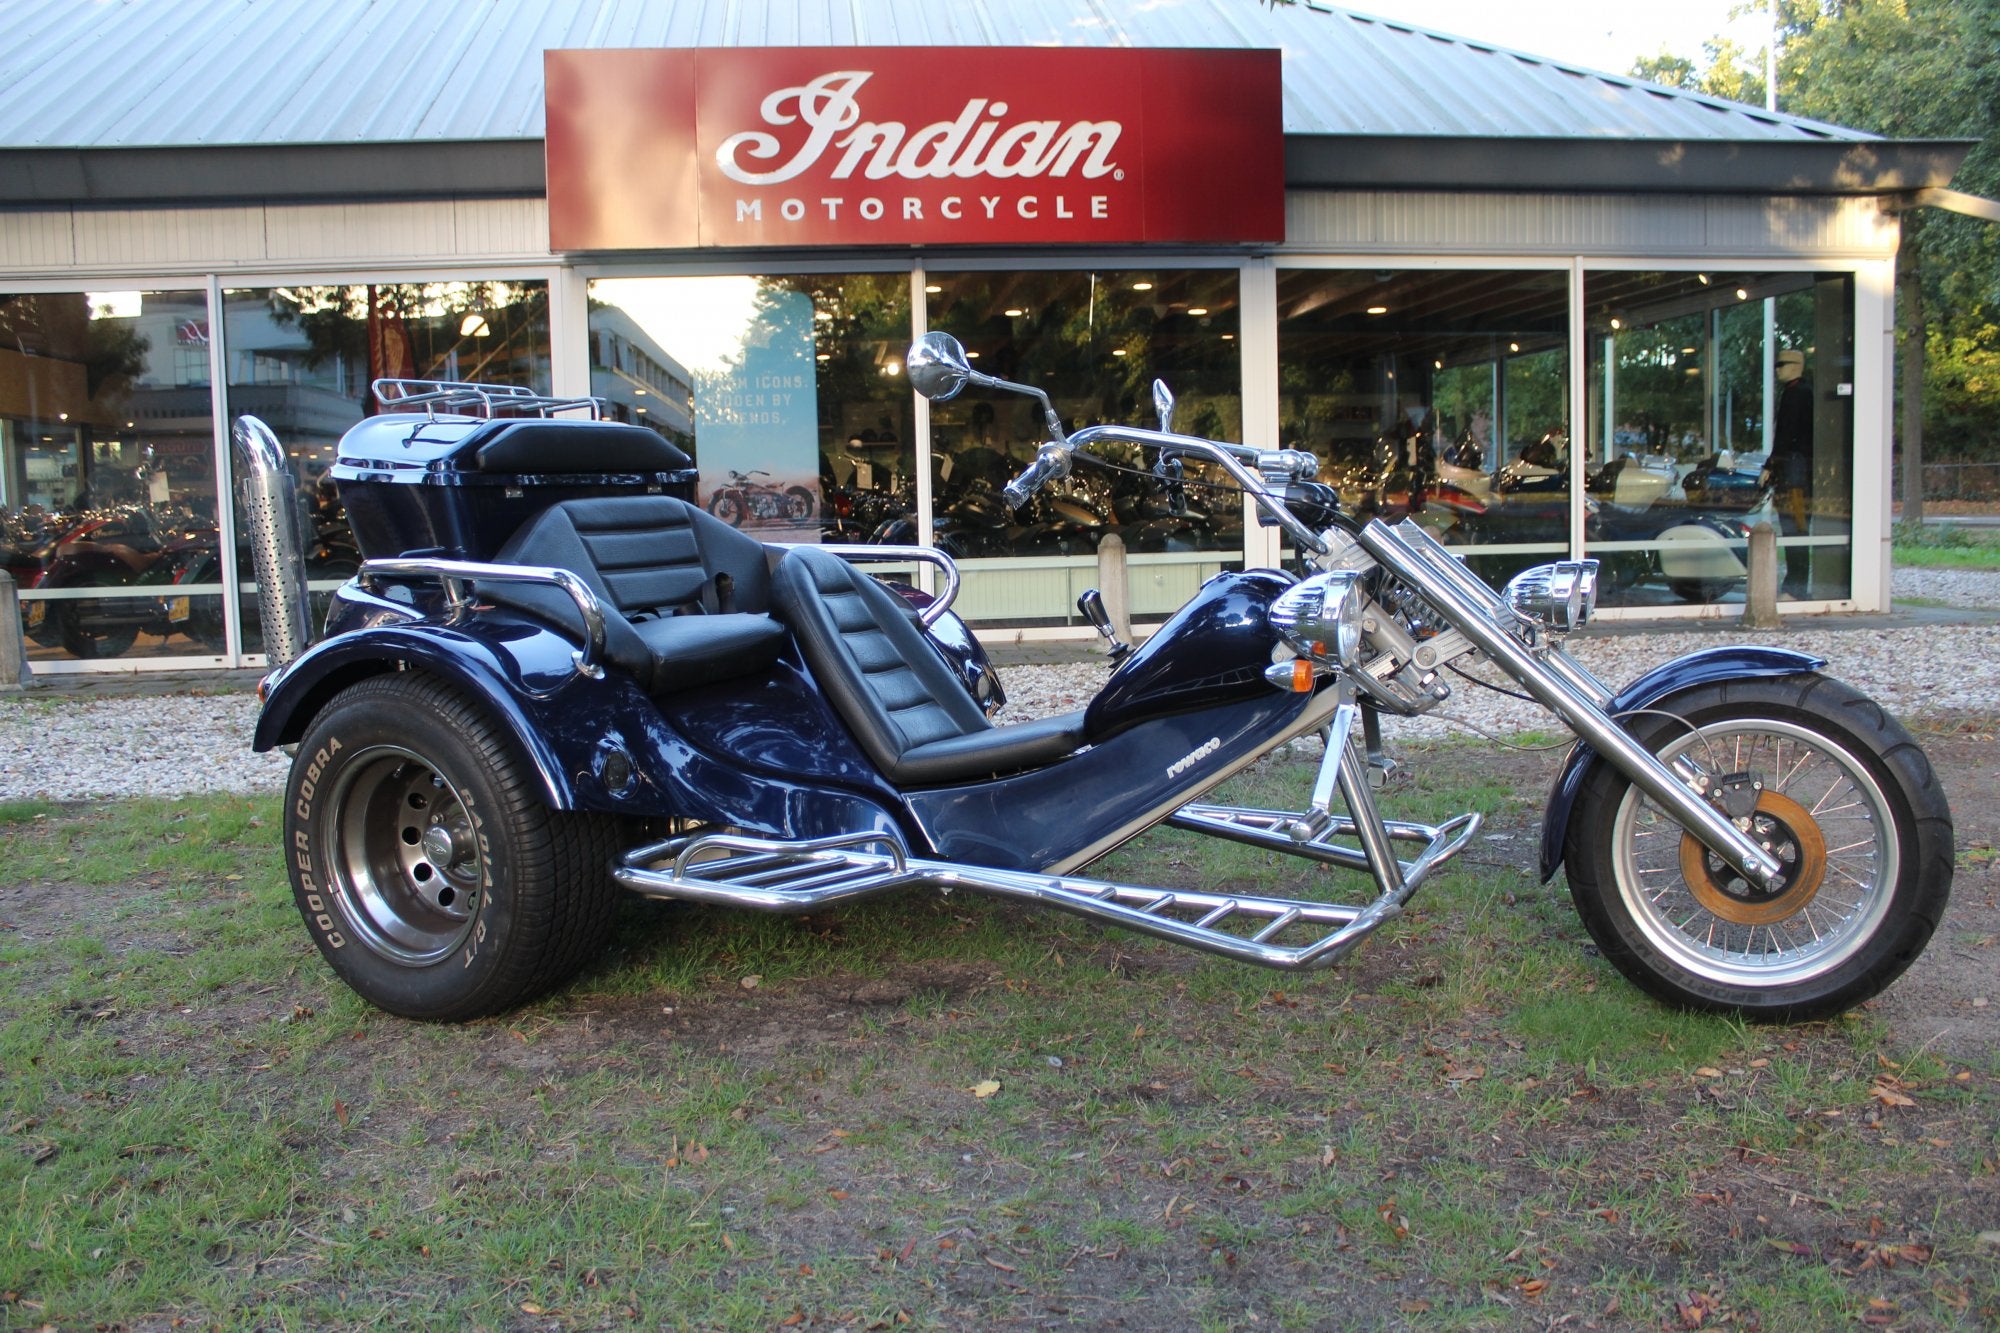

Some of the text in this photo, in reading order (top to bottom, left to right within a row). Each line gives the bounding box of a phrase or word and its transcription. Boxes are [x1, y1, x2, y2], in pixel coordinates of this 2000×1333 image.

[736, 195, 1109, 222] MOTORCYCLE
[755, 375, 808, 389] ICONS.
[772, 393, 792, 407] BY
[296, 736, 346, 949] COOPER COBRA
[460, 788, 493, 908] RADIAL
